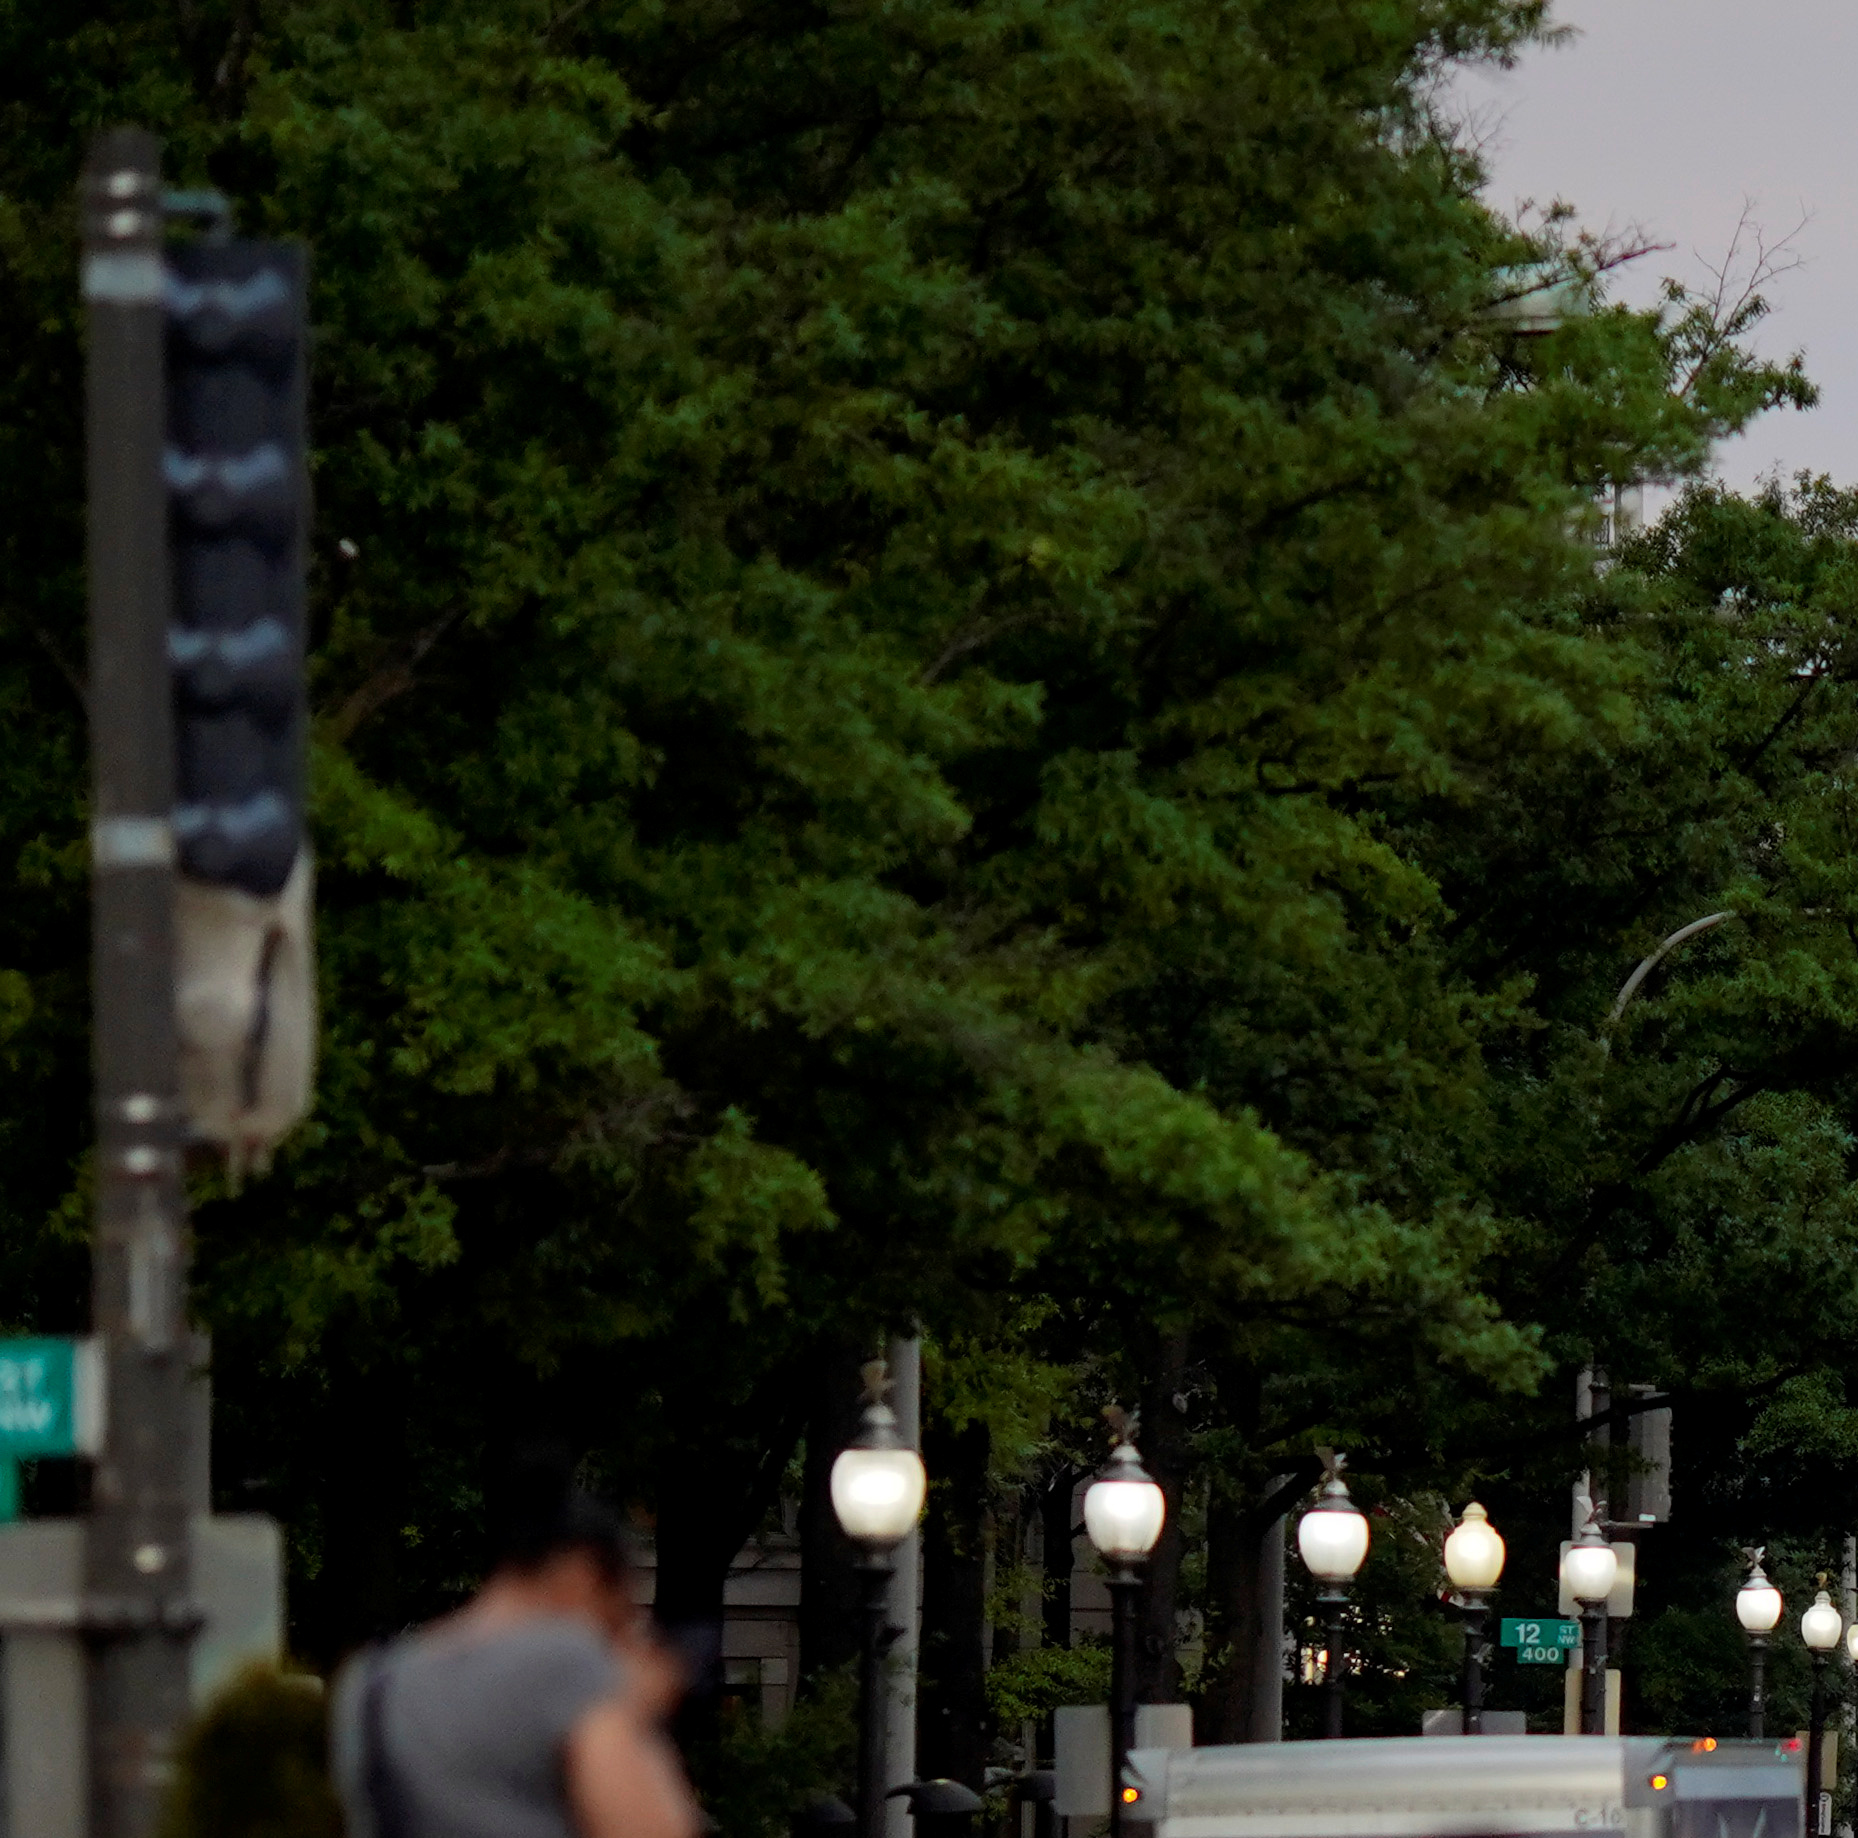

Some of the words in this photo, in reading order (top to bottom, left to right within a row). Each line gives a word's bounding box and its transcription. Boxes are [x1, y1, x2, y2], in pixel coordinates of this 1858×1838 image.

[1515, 1623, 1540, 1644] 12
[1560, 1625, 1576, 1635] ST
[1558, 1635, 1576, 1645] NW
[1522, 1647, 1560, 1662] 400
